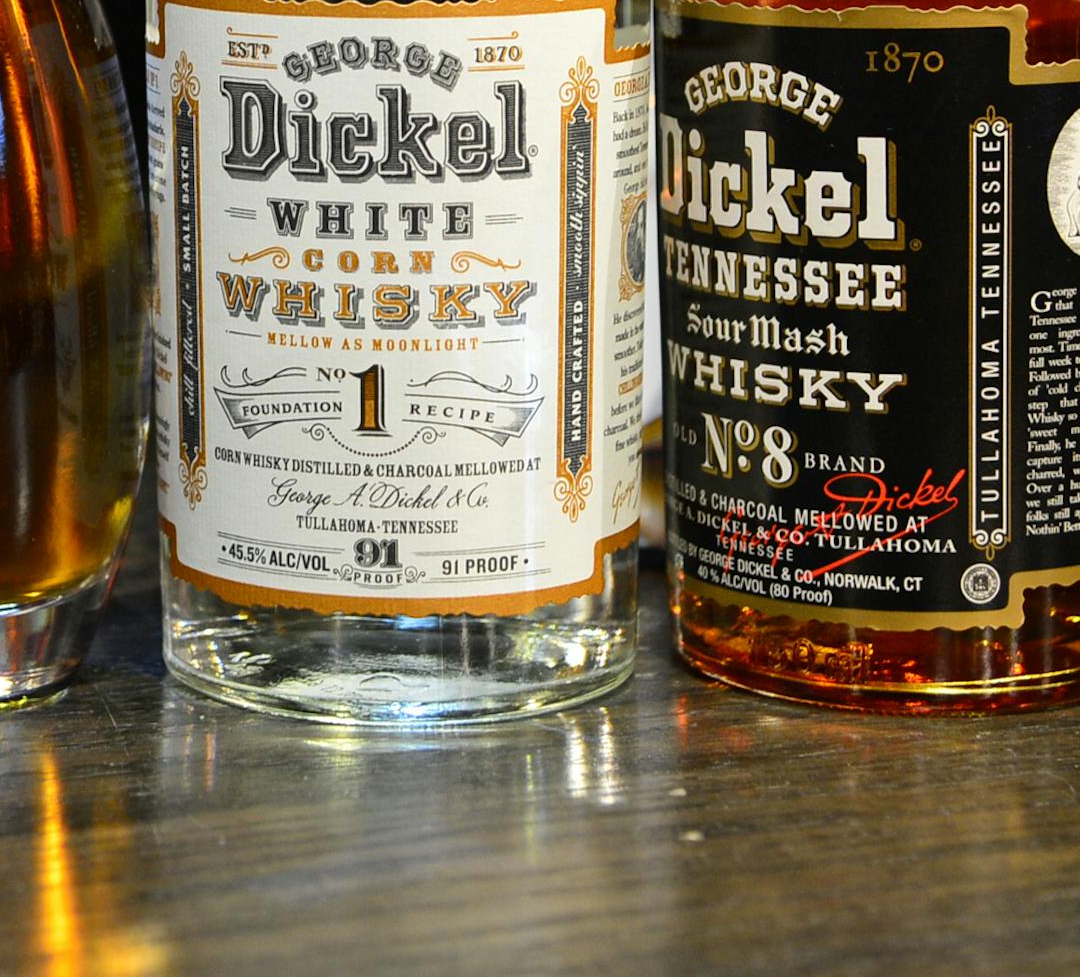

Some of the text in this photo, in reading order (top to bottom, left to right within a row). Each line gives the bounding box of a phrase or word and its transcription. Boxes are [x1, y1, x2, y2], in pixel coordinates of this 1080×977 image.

[281, 36, 464, 93] GEORGE
[473, 45, 524, 64] 1870
[865, 42, 945, 84] 1870
[683, 60, 844, 132] GEORGE
[219, 75, 533, 184] Dickel
[660, 113, 905, 251] Dickel
[266, 197, 475, 242] WHITE
[569, 211, 584, 277] smooth
[301, 248, 435, 274] CORN
[663, 234, 908, 312] TENNESSEE
[180, 145, 201, 417] chill filtered SMALL BATCH
[215, 271, 538, 330] WHISKY
[1029, 287, 1078, 314] George
[685, 302, 851, 357] Sour Mash
[980, 138, 1000, 523] TULLAHOMA TENNESSEE
[1028, 314, 1078, 327] Tennessee
[1028, 331, 1049, 341] one
[267, 332, 479, 352] MELLOW AS MOONLIGHT
[570, 299, 584, 384] CRAFTED
[1028, 344, 1056, 355] most.
[666, 339, 908, 414] WHISKY
[1028, 354, 1072, 369] full week
[1028, 368, 1072, 383] Followed
[242, 400, 496, 424] FOUNDATION RECIPE
[348, 364, 392, 438] 1
[570, 388, 582, 442] HAND
[1027, 400, 1049, 413] step
[1027, 410, 1066, 425] Whisky
[761, 425, 800, 490] 8
[803, 451, 886, 474] BRAND
[1026, 455, 1063, 469] capture
[1027, 439, 1062, 454] Finally,
[214, 447, 542, 478] CORN WHISKY DISTILLED & CHARCOAL MELLOWED AT
[1026, 466, 1066, 481] charred,
[267, 476, 332, 514] George
[367, 480, 443, 510] Dickel
[445, 484, 466, 505] &
[823, 467, 966, 518] Dickel
[1026, 482, 1053, 495] Over
[296, 514, 459, 534] TULLAHOMA TENNESSEE
[699, 489, 929, 534] & CHARCOAL MELLOWED AT
[1026, 510, 1050, 522] folks
[697, 509, 752, 537] DICKEL
[756, 525, 770, 541] &
[775, 527, 810, 546] CO.
[814, 532, 957, 554] TULLAHOMA
[1025, 522, 1063, 537] Nothin'
[228, 546, 331, 573] 45.5% ALC/VOL
[352, 537, 403, 569] 91
[715, 534, 794, 562] TENNESSEE
[352, 571, 404, 585] PROOF
[441, 554, 519, 576] 91 PROOF
[687, 543, 697, 558] BY
[698, 547, 735, 571] GEORGE
[737, 559, 779, 582] DICKEL
[781, 567, 791, 582] &
[824, 571, 900, 593] NORWALK,
[903, 576, 924, 592] CT
[696, 564, 833, 607] 40 % ALC/VOL (80 Proof)
